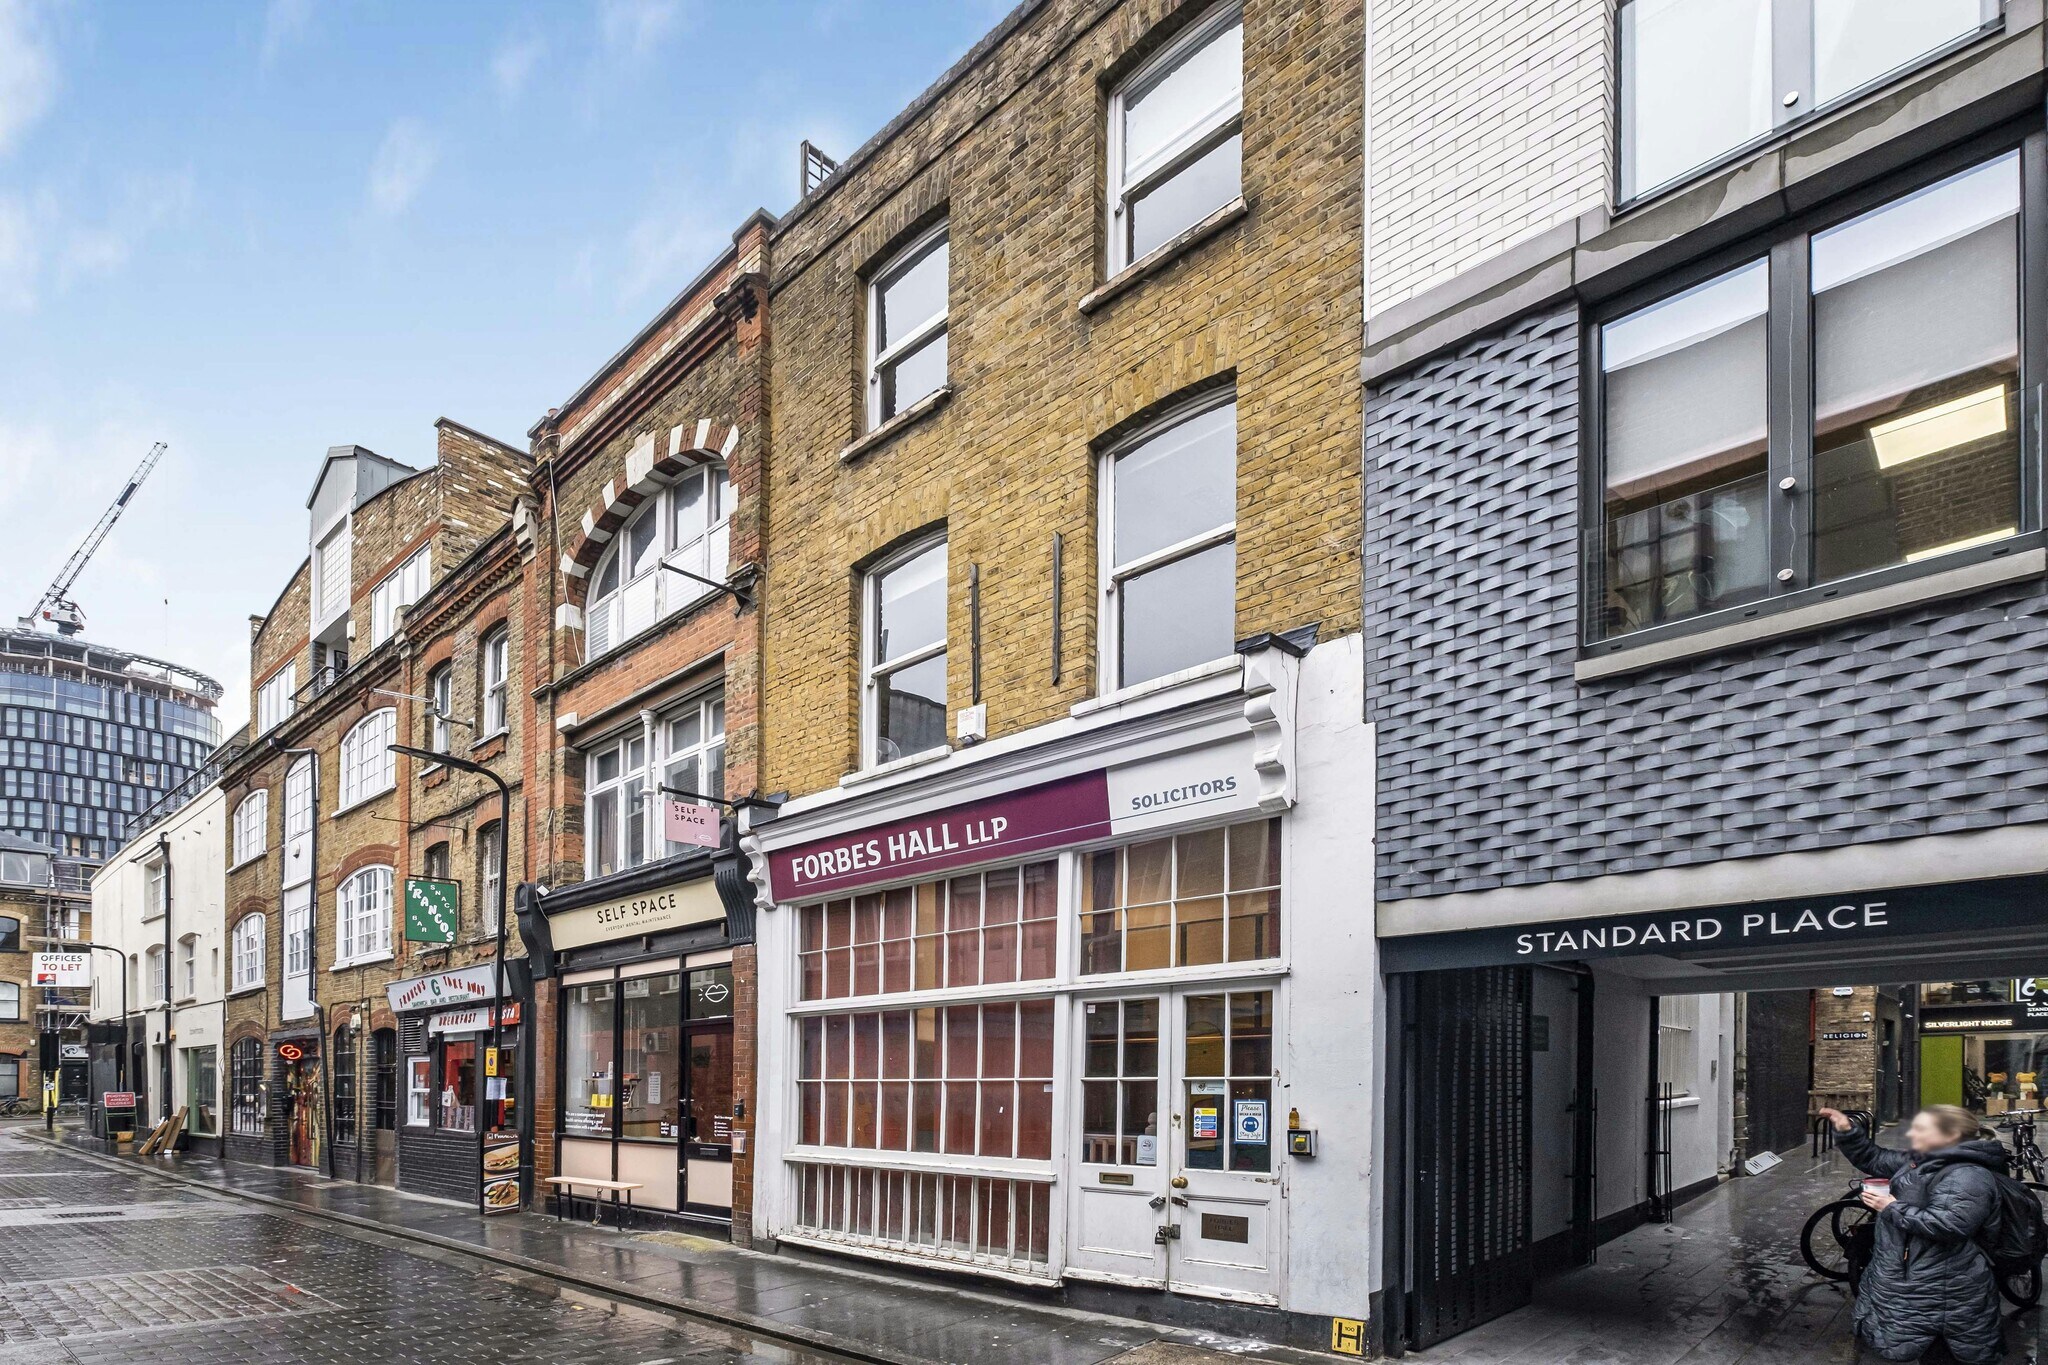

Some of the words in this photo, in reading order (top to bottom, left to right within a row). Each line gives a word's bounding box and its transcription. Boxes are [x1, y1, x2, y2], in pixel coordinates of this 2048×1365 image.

[1132, 775, 1237, 811] SOLICITORS
[674, 805, 697, 815] SELF
[674, 814, 705, 825] SPACE
[791, 838, 882, 883] FORBES
[888, 822, 959, 862] HALL
[965, 816, 1008, 846] LLP
[408, 880, 455, 942] FRANCOS
[430, 884, 455, 915] SNACK
[597, 904, 626, 924] SELF
[632, 893, 676, 917] SPACE
[412, 915, 427, 933] BAR
[1516, 918, 1723, 955] STANDARD
[1742, 902, 1888, 937] PLACE
[41, 954, 83, 962] OFFICES
[42, 963, 58, 971] TO
[61, 963, 82, 971] LET
[399, 979, 427, 1009] FRANCO'S
[430, 978, 441, 997] G
[442, 975, 463, 990] TAKE
[467, 981, 485, 997] AWAY
[438, 1012, 477, 1027] BREAKFAST
[1924, 1020, 1981, 1029] SILVERLIGHT
[1981, 1019, 2013, 1027] HOUSE
